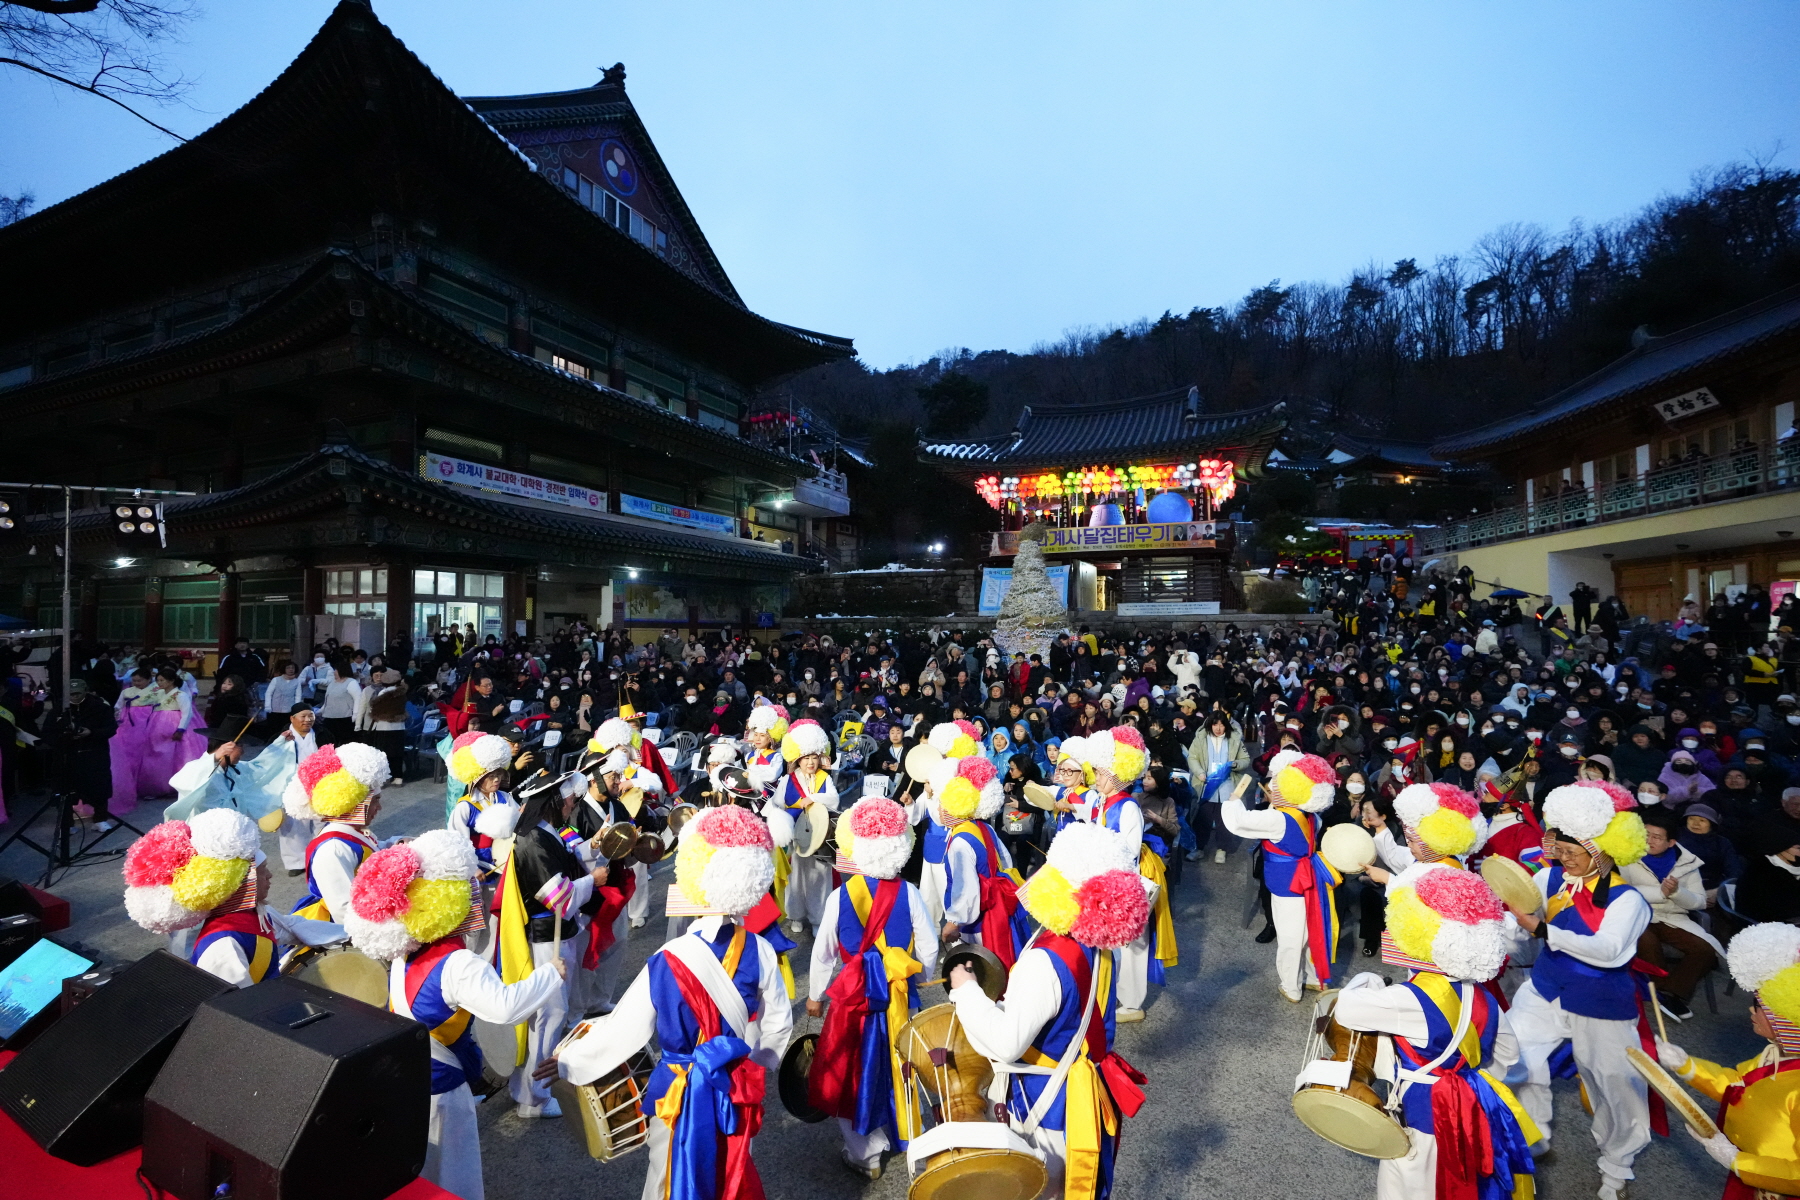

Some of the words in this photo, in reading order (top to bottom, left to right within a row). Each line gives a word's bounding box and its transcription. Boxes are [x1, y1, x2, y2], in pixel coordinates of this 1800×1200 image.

[456, 462, 483, 478] 화계사
[567, 486, 588, 500] 입학식
[865, 781, 886, 790] 내빈석
